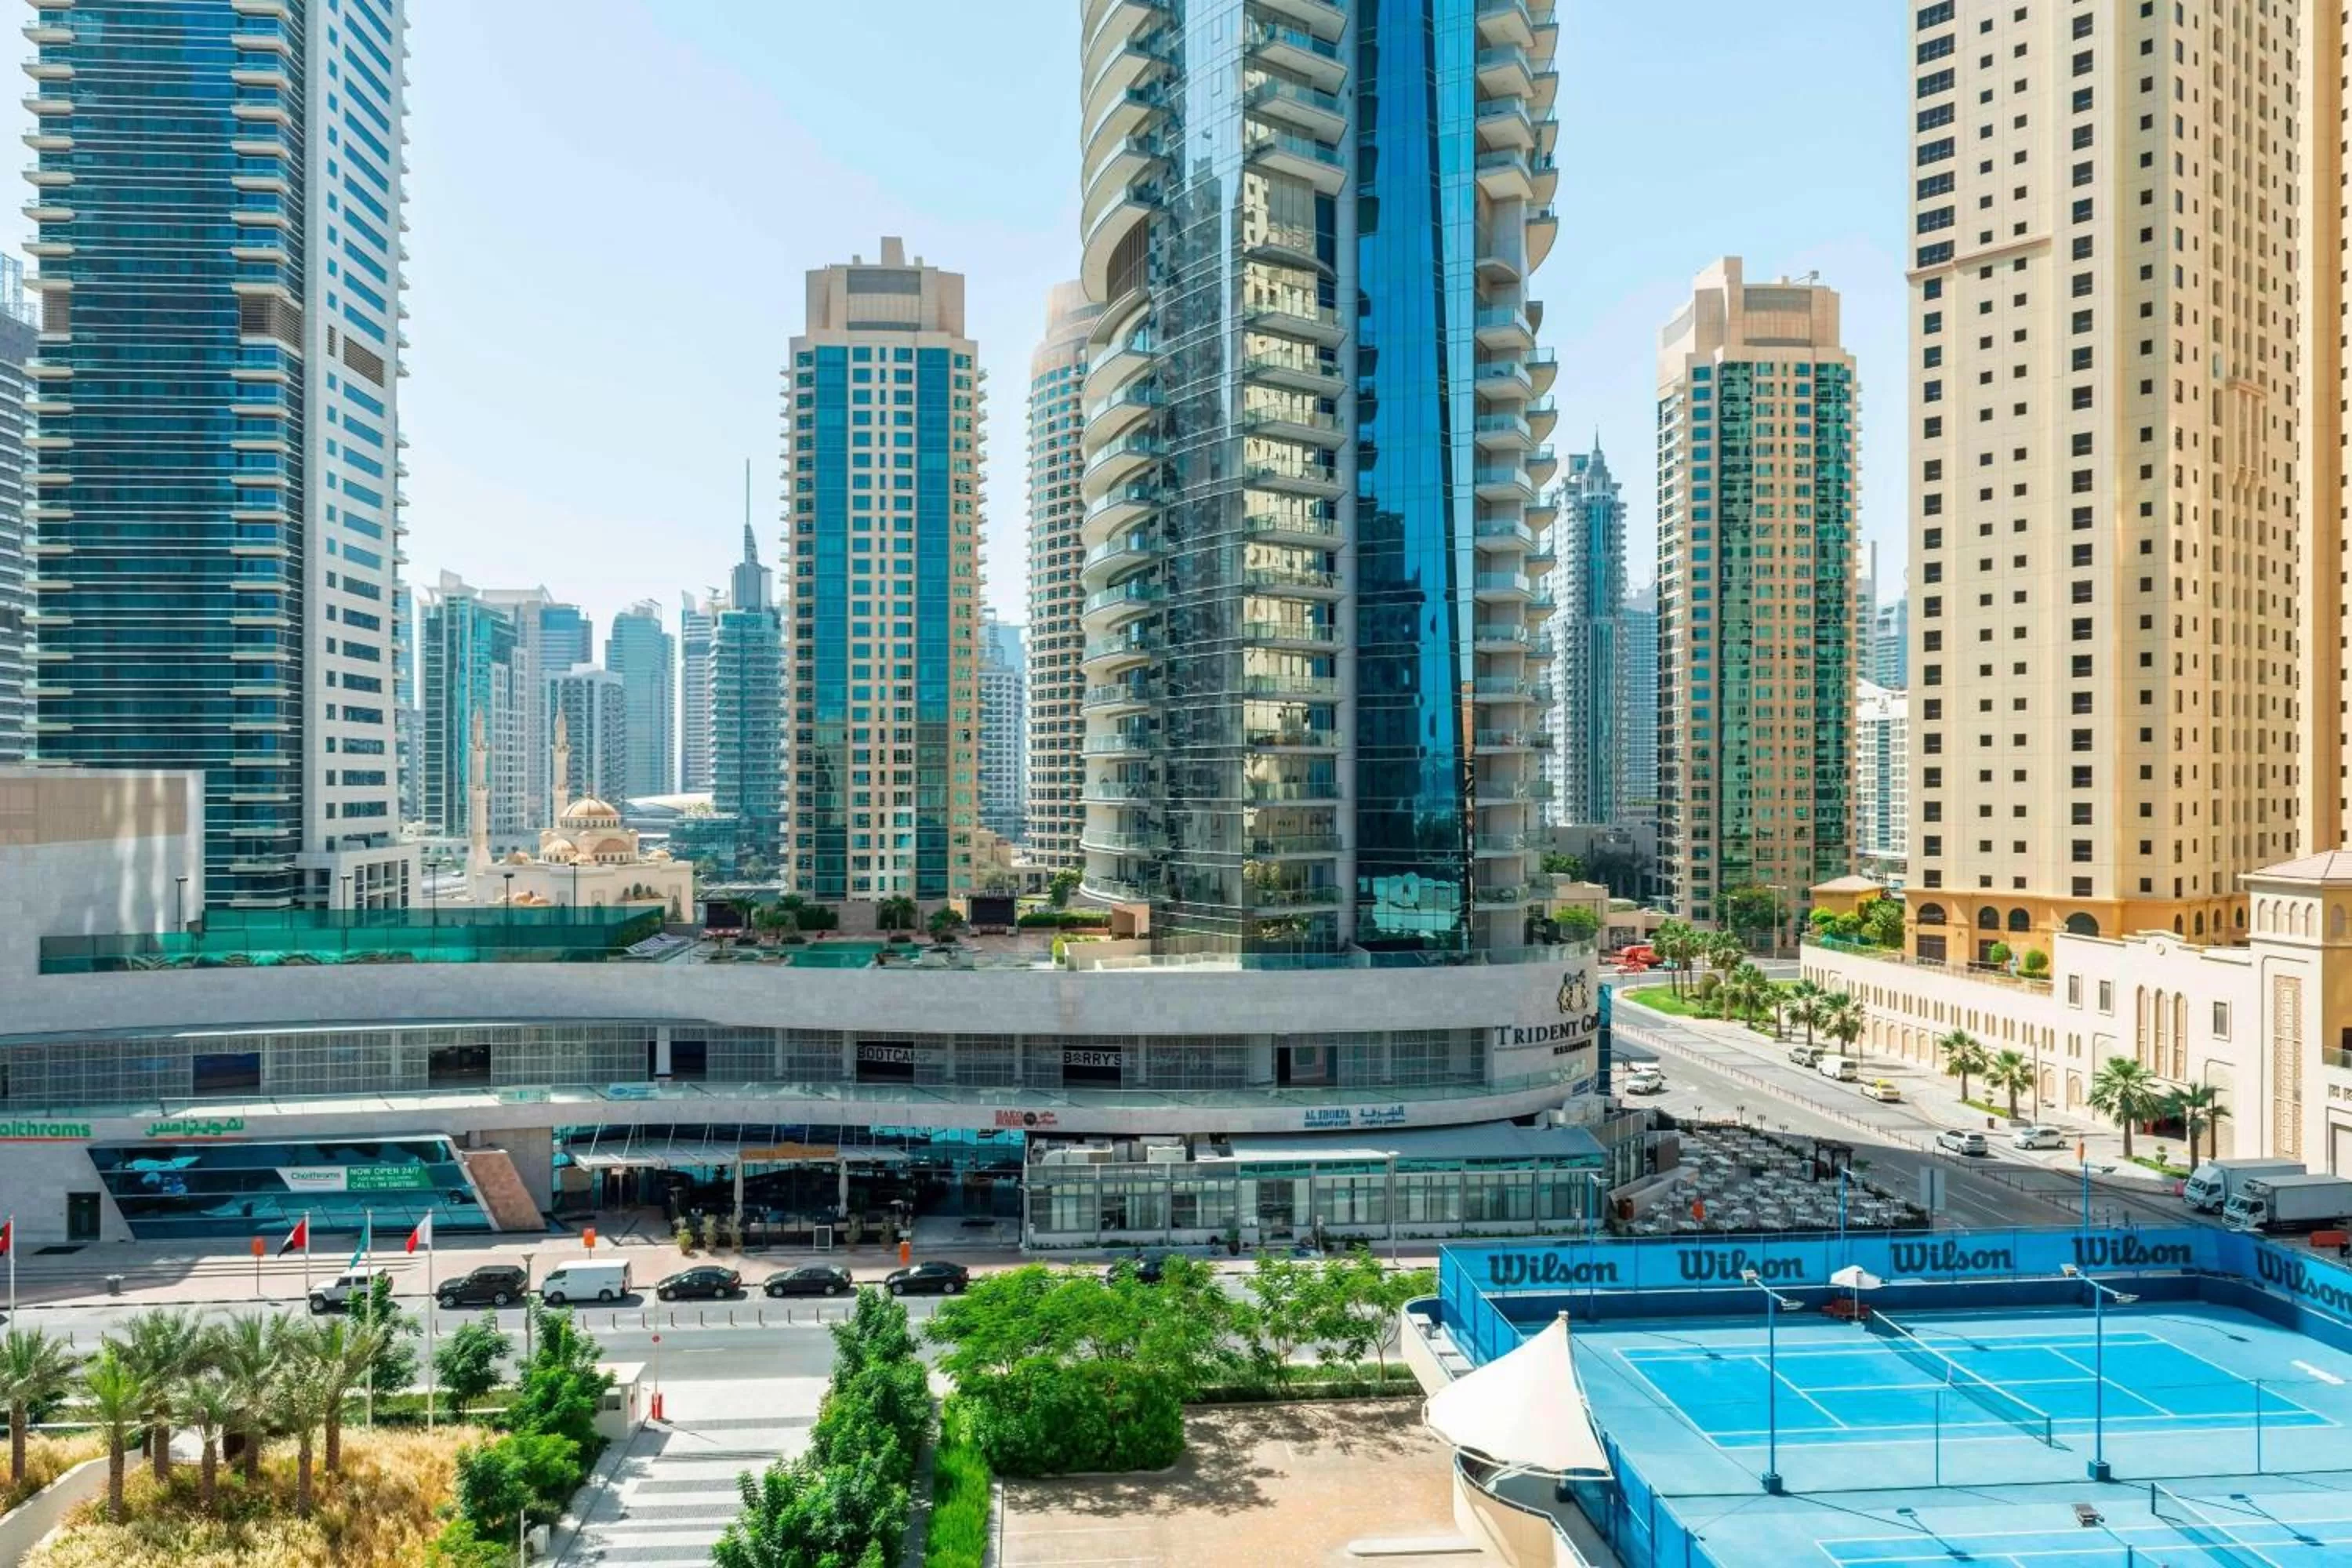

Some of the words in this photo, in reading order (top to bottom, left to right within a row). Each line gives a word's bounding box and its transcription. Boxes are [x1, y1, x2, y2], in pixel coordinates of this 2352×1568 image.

[1494, 1021, 1578, 1045] TRIDENT
[374, 1167, 399, 1175] OPEN
[1890, 1240, 2015, 1273] Wilson
[2071, 1235, 2193, 1267] Wilson
[1487, 1252, 1619, 1286] Wilson
